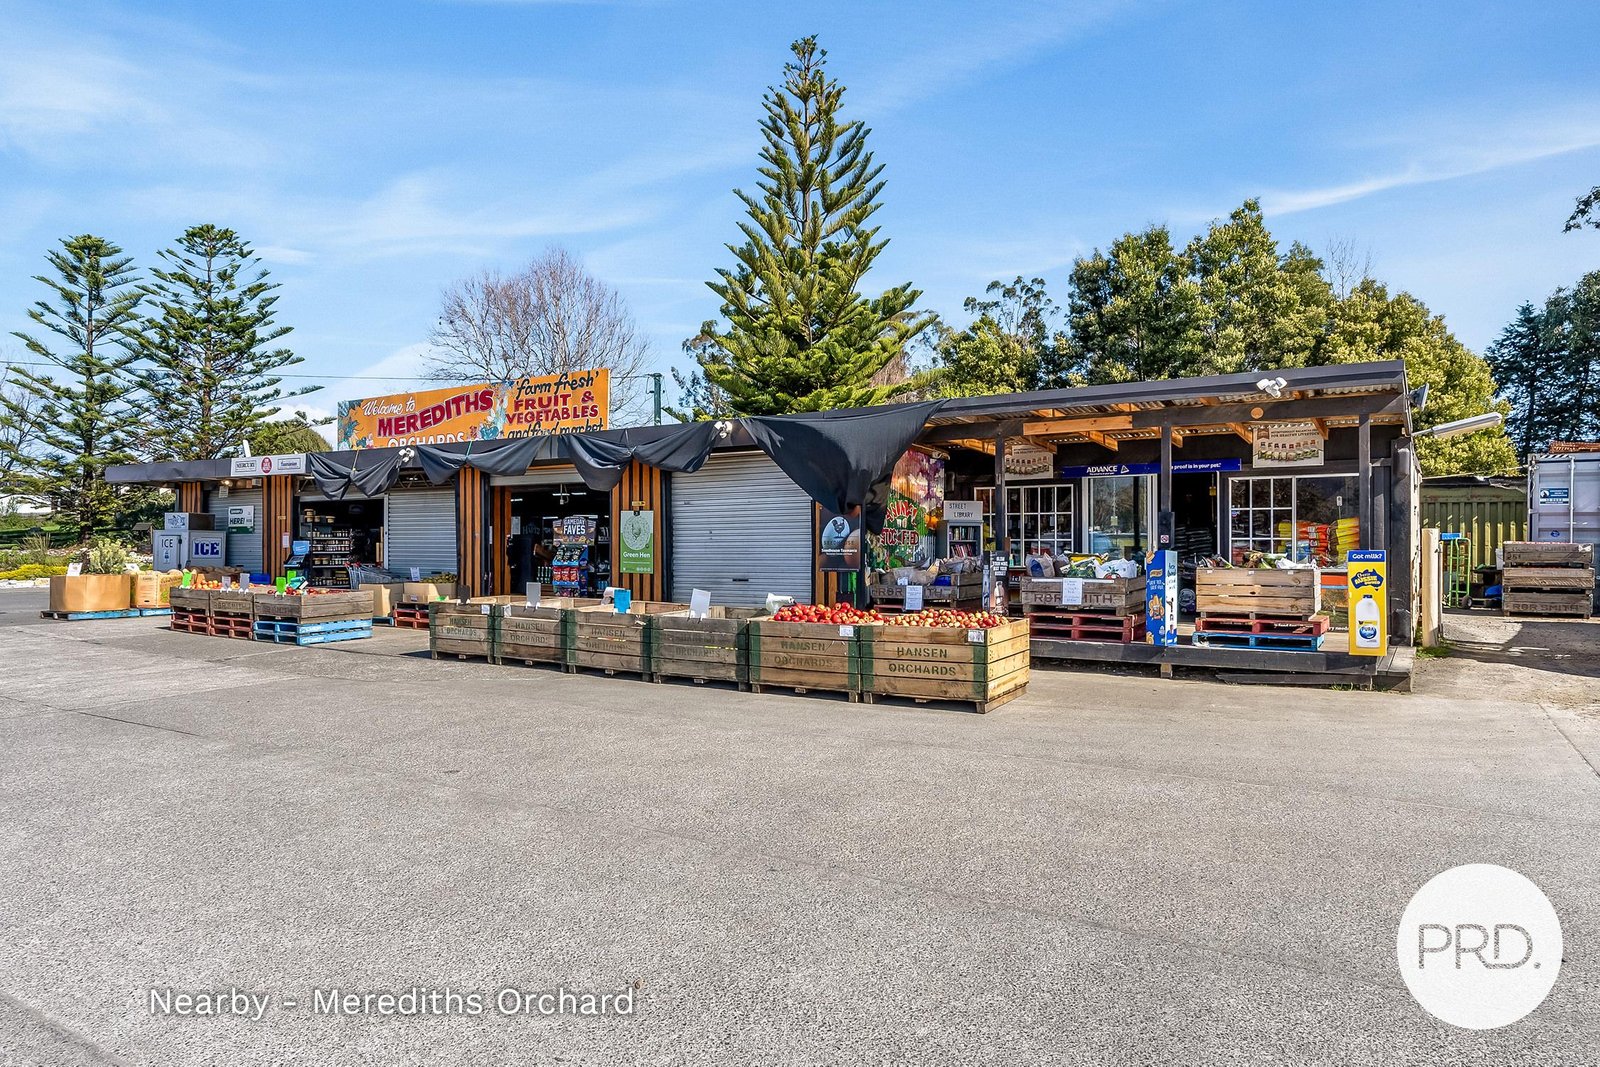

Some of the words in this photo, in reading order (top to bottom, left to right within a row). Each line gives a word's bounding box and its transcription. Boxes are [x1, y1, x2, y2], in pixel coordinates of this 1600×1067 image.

[362, 400, 404, 416] Welcome
[406, 396, 415, 411] to
[513, 394, 571, 412] FRUIT
[581, 391, 594, 404] &
[378, 389, 494, 437] MEREDITHS
[505, 404, 599, 424] VEGETABLES
[1087, 465, 1117, 473] ADVANCE
[563, 525, 586, 535] FAVES
[161, 539, 173, 548] ICE
[194, 542, 220, 555] ICE
[780, 641, 826, 651] HANSEN
[896, 646, 948, 658] HANSEN
[774, 656, 833, 668] ORCHARDS
[888, 663, 957, 676] ORCHARDS
